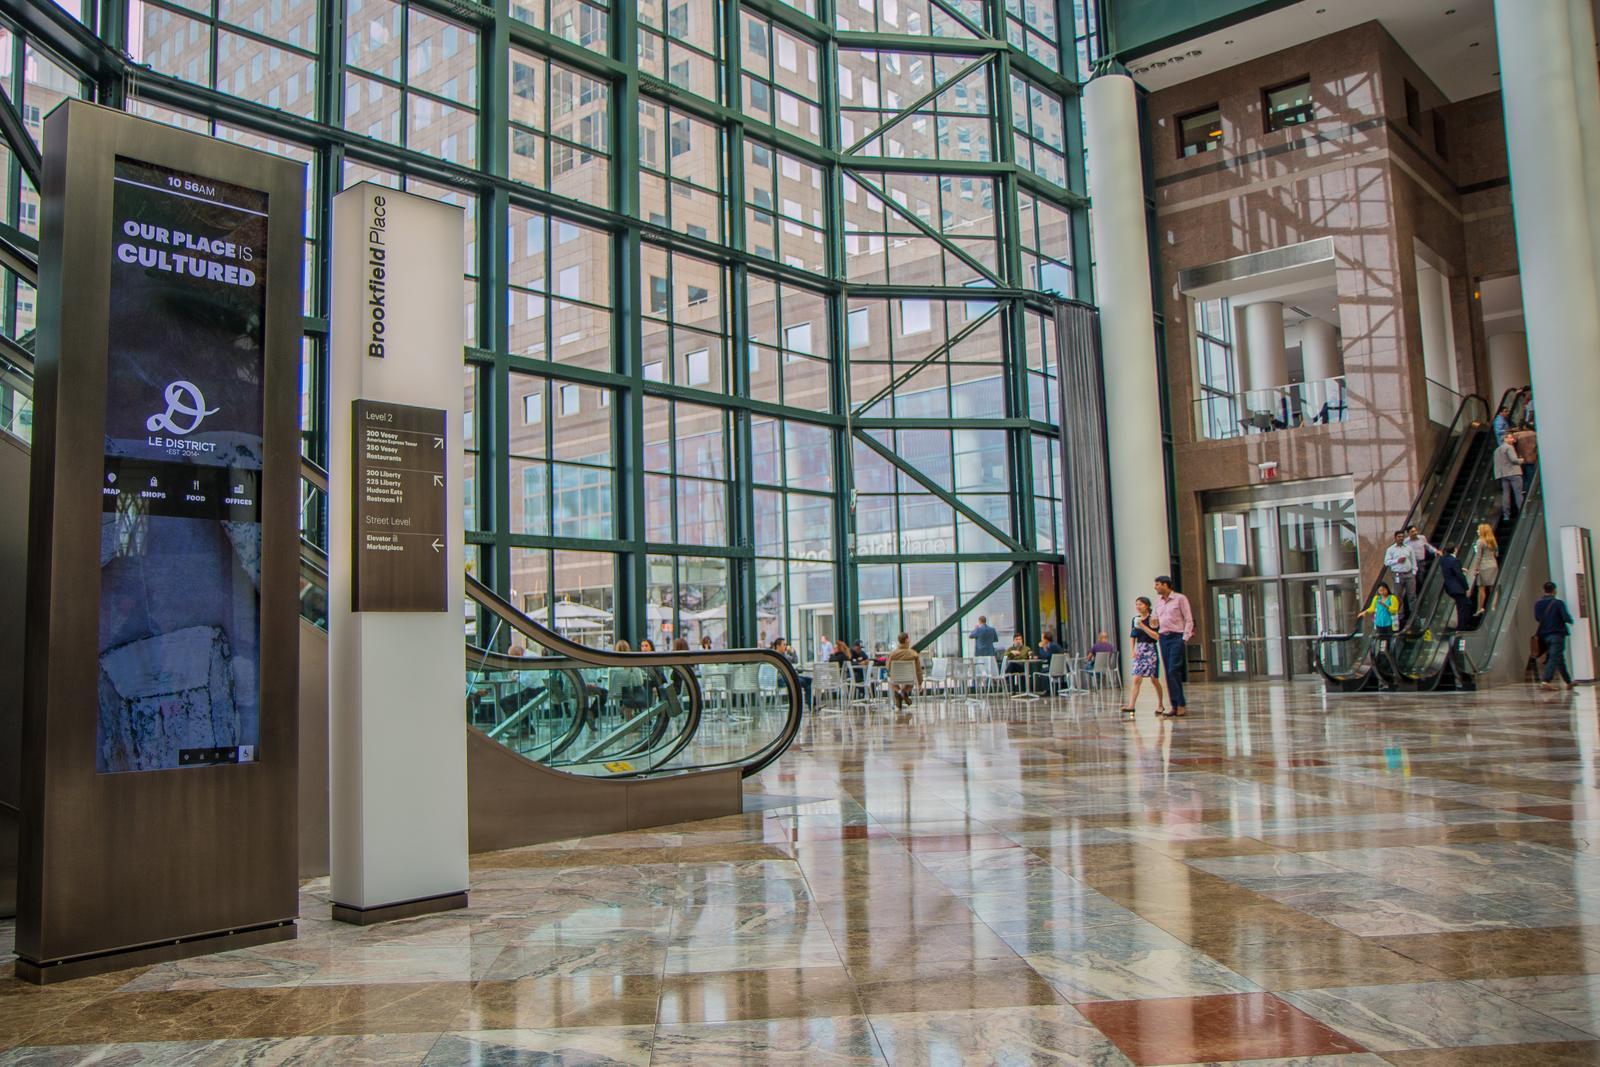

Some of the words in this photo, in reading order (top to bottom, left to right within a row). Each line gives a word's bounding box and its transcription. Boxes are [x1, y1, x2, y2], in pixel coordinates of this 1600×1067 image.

[370, 195, 386, 246] Place
[123, 220, 169, 243] OUR
[173, 230, 236, 258] PLACE
[238, 245, 253, 261] IS
[117, 243, 256, 287] CULTURED
[369, 247, 385, 358] Brookfield
[366, 411, 386, 421] Level
[387, 413, 393, 422] 2
[380, 431, 398, 440] Vesey
[148, 436, 163, 447] LE
[166, 438, 216, 452] DISTRICT
[380, 445, 398, 454] Vesey
[366, 453, 402, 462] Restaurants
[380, 470, 401, 479] Liberty
[380, 479, 401, 488] Liberty
[141, 491, 166, 499] SHOPS
[186, 494, 206, 502] FOOD
[366, 495, 395, 503] Restroom
[225, 497, 252, 506] OFFICES
[366, 515, 389, 525] Street
[390, 517, 411, 526] Level
[366, 534, 391, 542] Elevator
[366, 543, 404, 551] Marketplace
